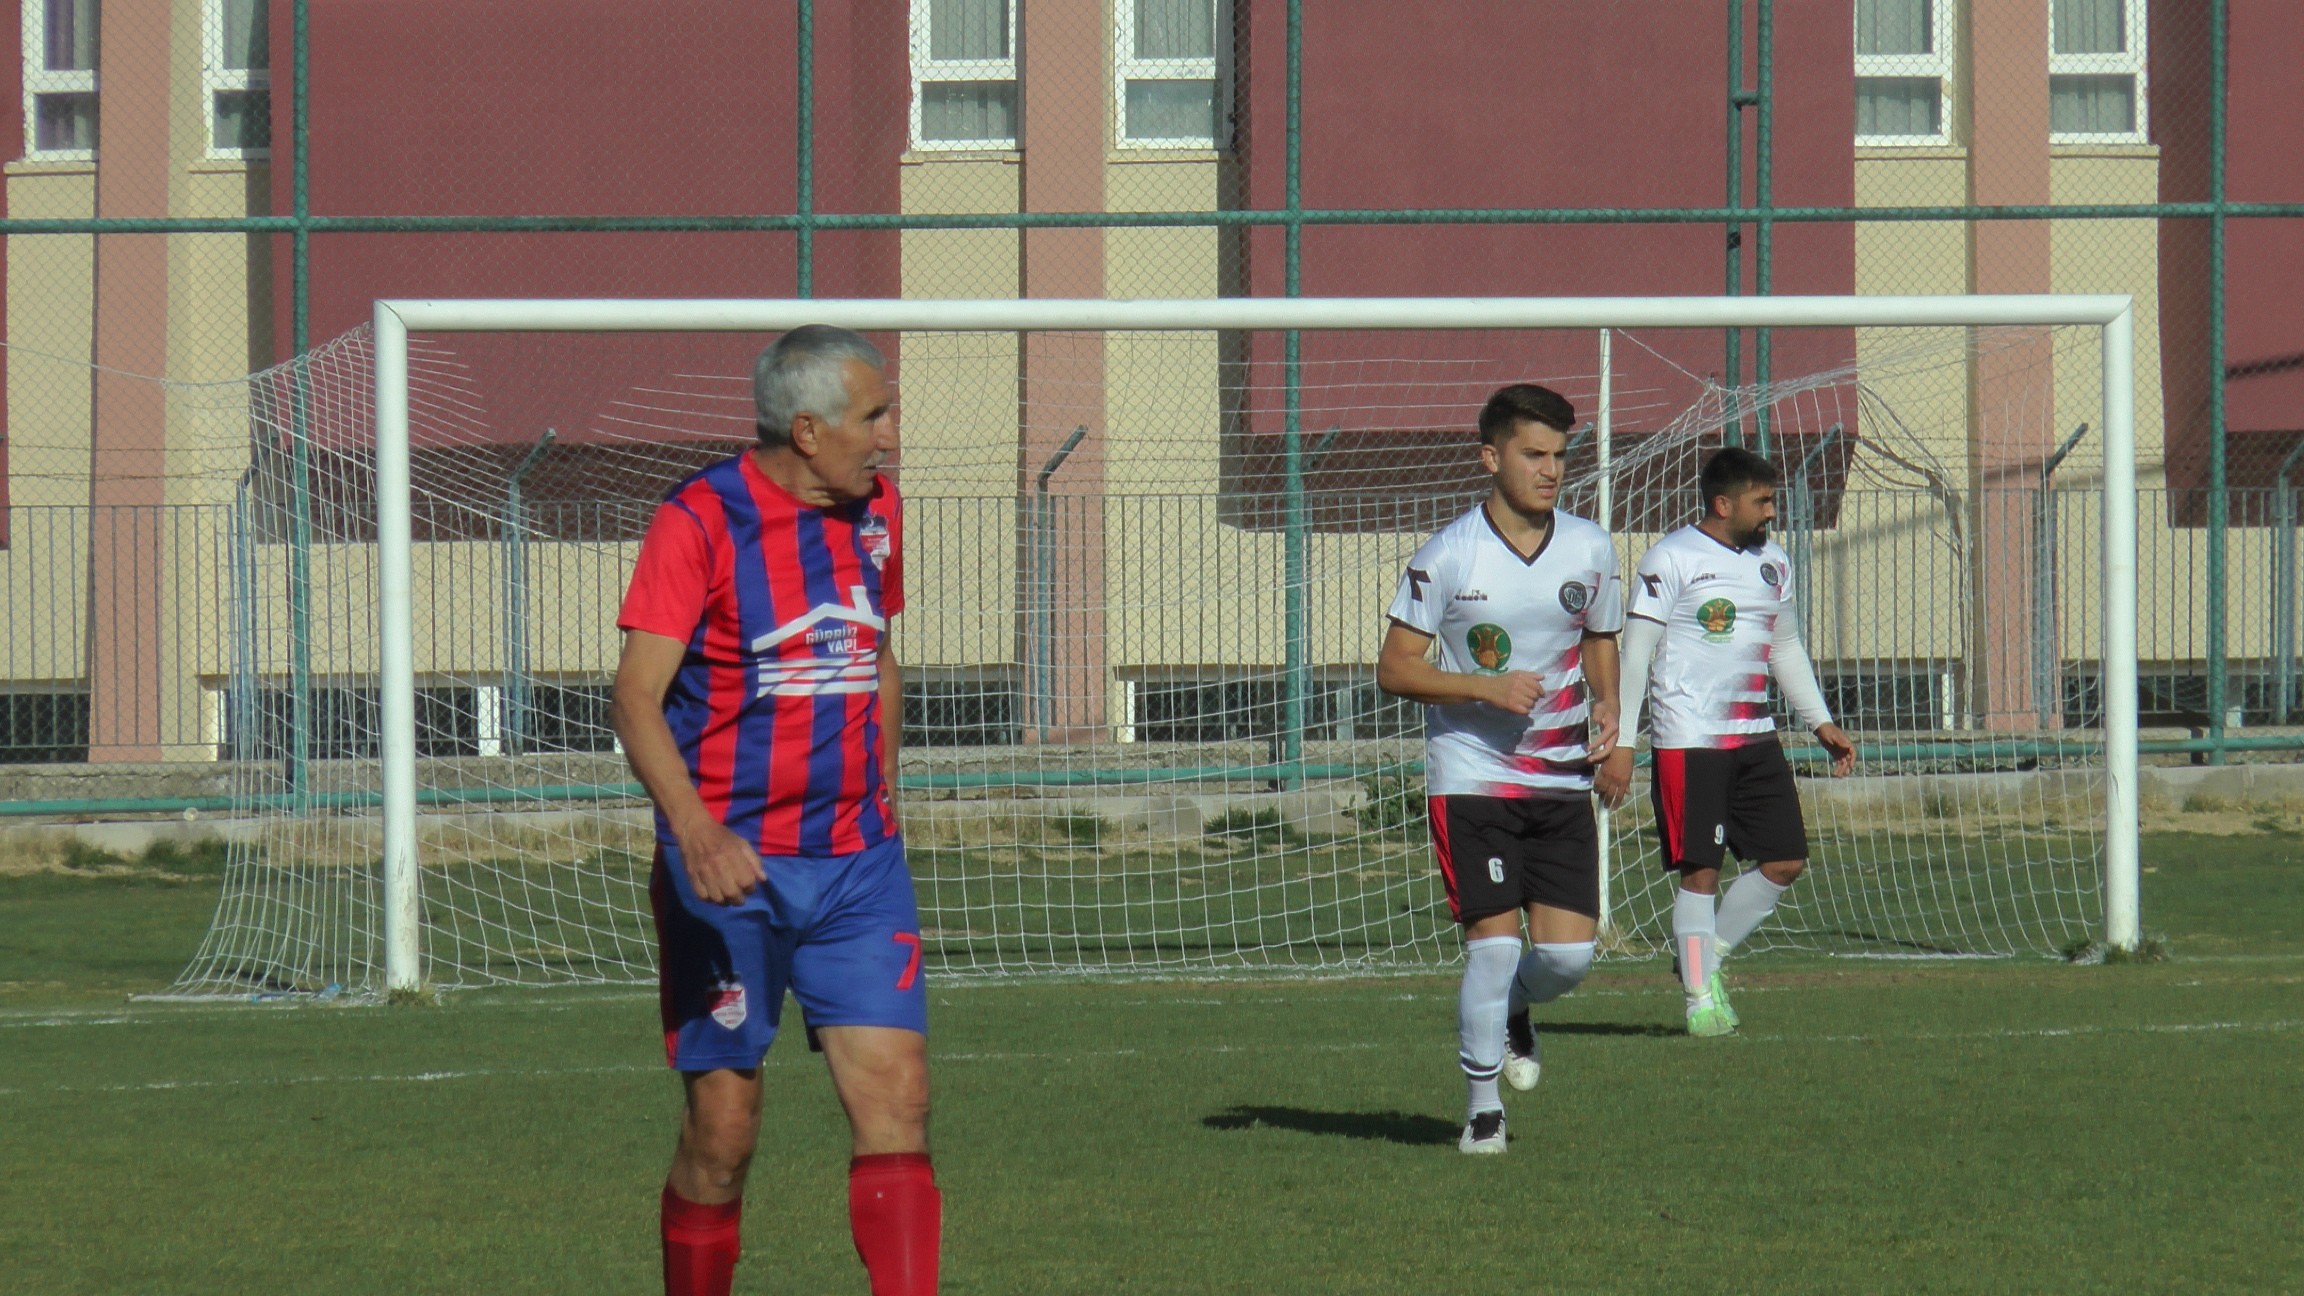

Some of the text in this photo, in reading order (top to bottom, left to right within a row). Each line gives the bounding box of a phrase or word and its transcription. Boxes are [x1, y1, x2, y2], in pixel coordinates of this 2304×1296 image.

[827, 638, 857, 653] YAPI
[1714, 824, 1724, 845] 9
[1488, 858, 1504, 883] 6
[893, 932, 922, 990] 7
